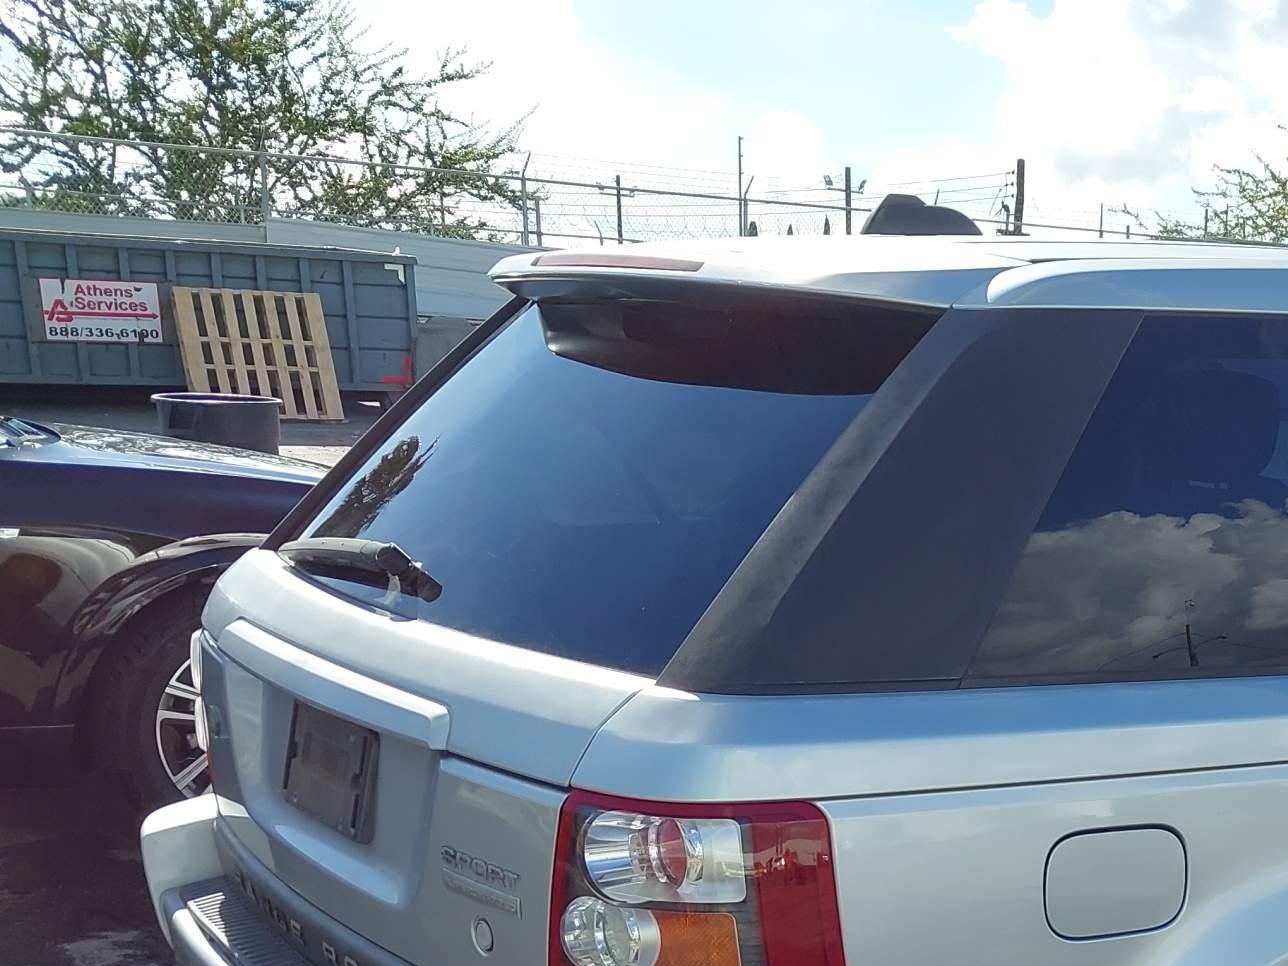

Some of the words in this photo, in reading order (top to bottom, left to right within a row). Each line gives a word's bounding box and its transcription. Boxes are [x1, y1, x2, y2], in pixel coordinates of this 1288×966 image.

[75, 284, 133, 298] Athens
[75, 297, 148, 312] Services
[48, 326, 159, 338] 888/336-6100
[440, 846, 520, 890] SPORT
